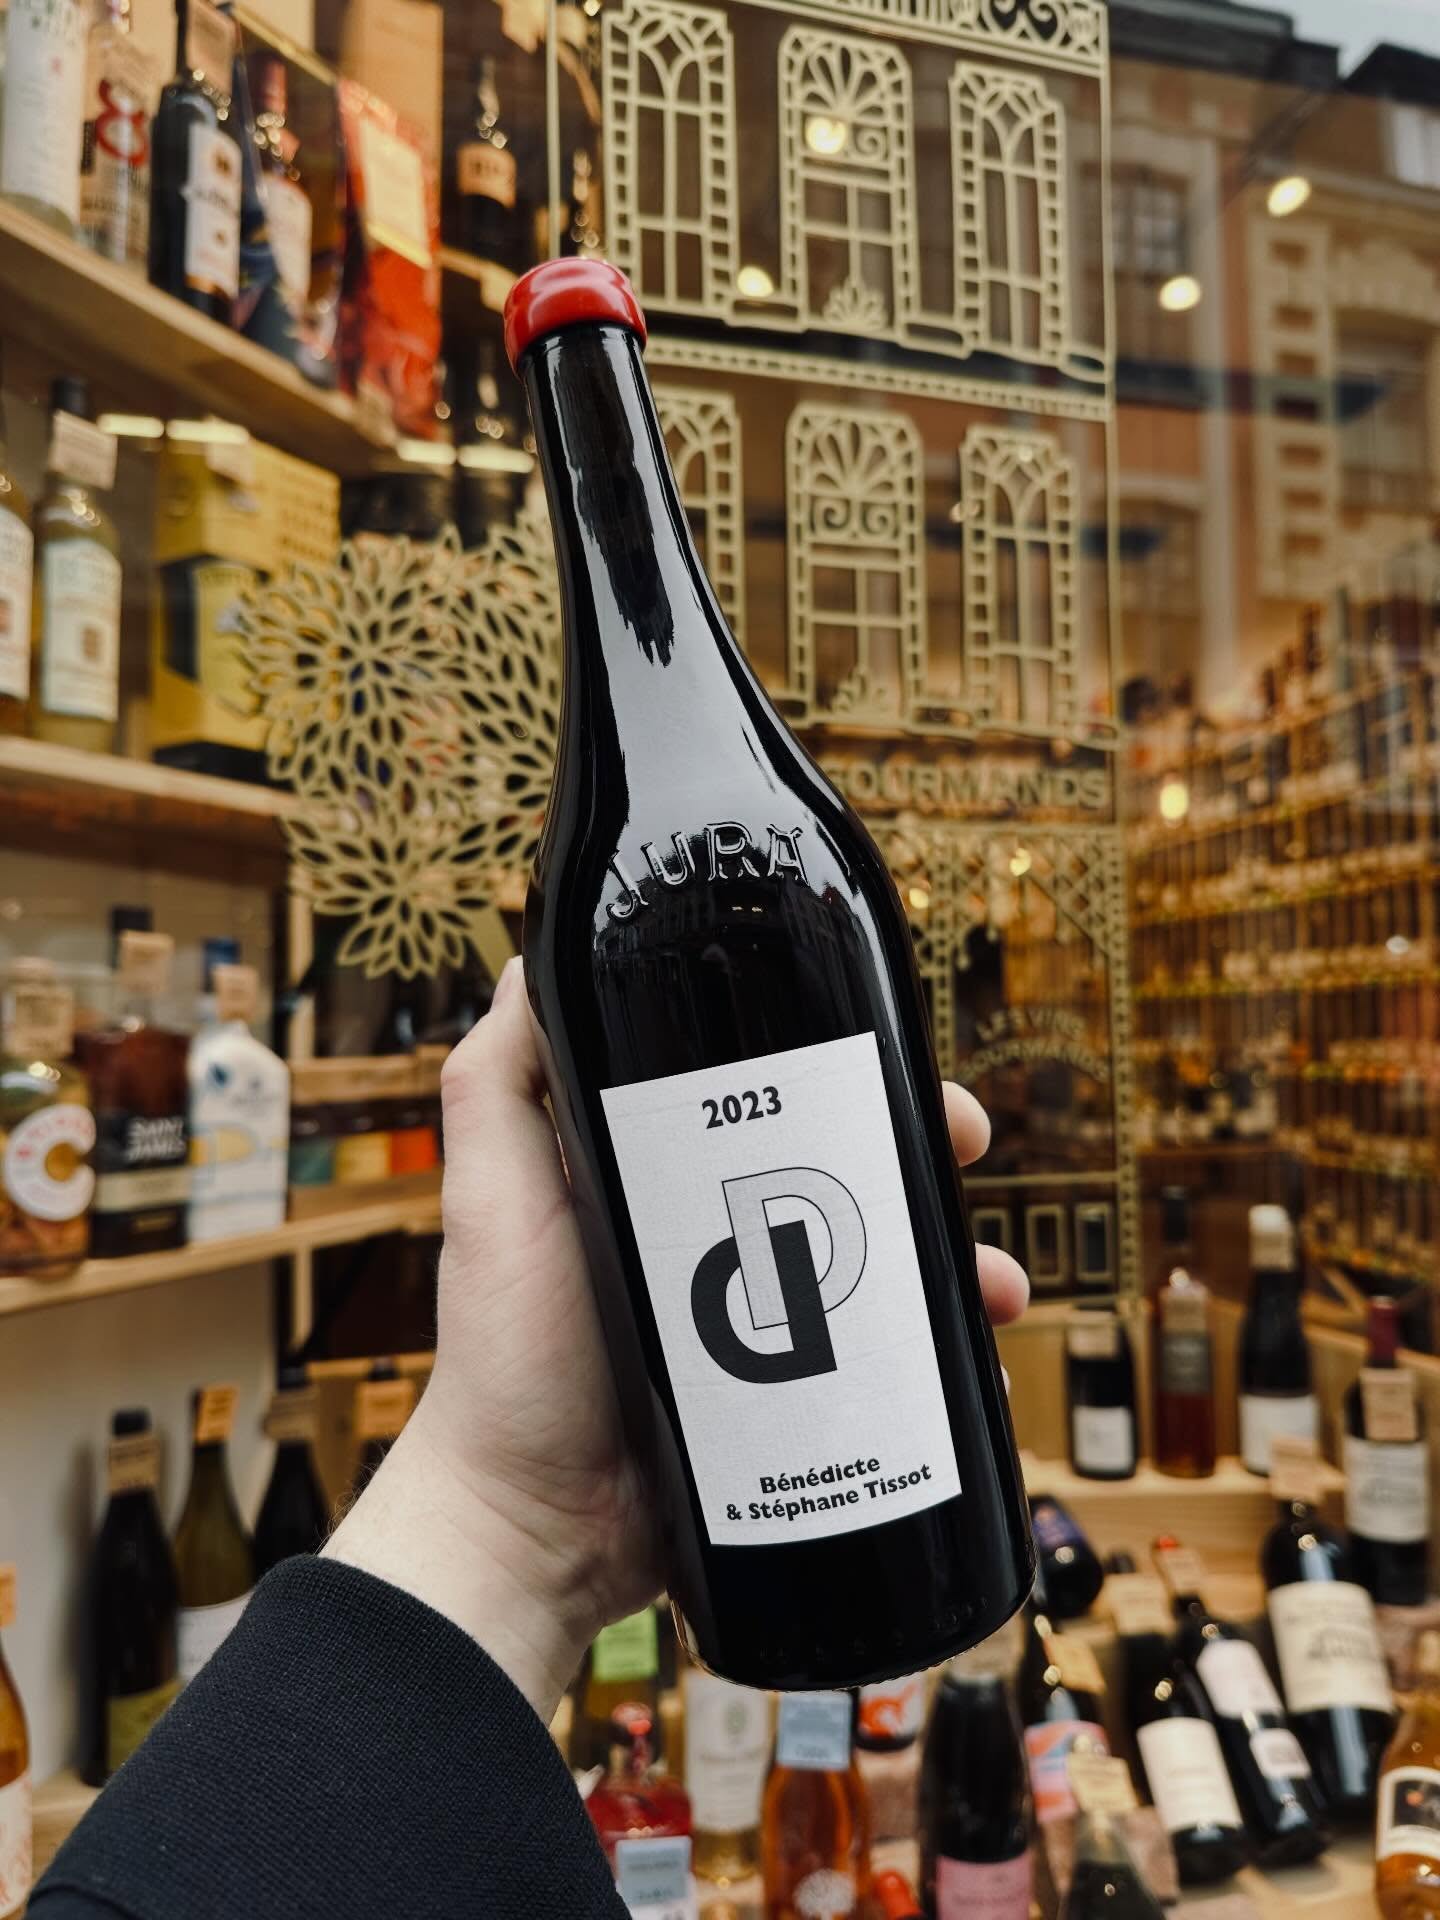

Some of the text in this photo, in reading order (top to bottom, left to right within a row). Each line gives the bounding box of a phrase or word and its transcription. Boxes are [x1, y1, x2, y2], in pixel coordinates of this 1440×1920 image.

[605, 821, 810, 922] JURA
[702, 1086, 782, 1129] 2023
[726, 1463, 932, 1521] & Stéphane Tissot
[759, 1457, 881, 1494] Bénédicte
